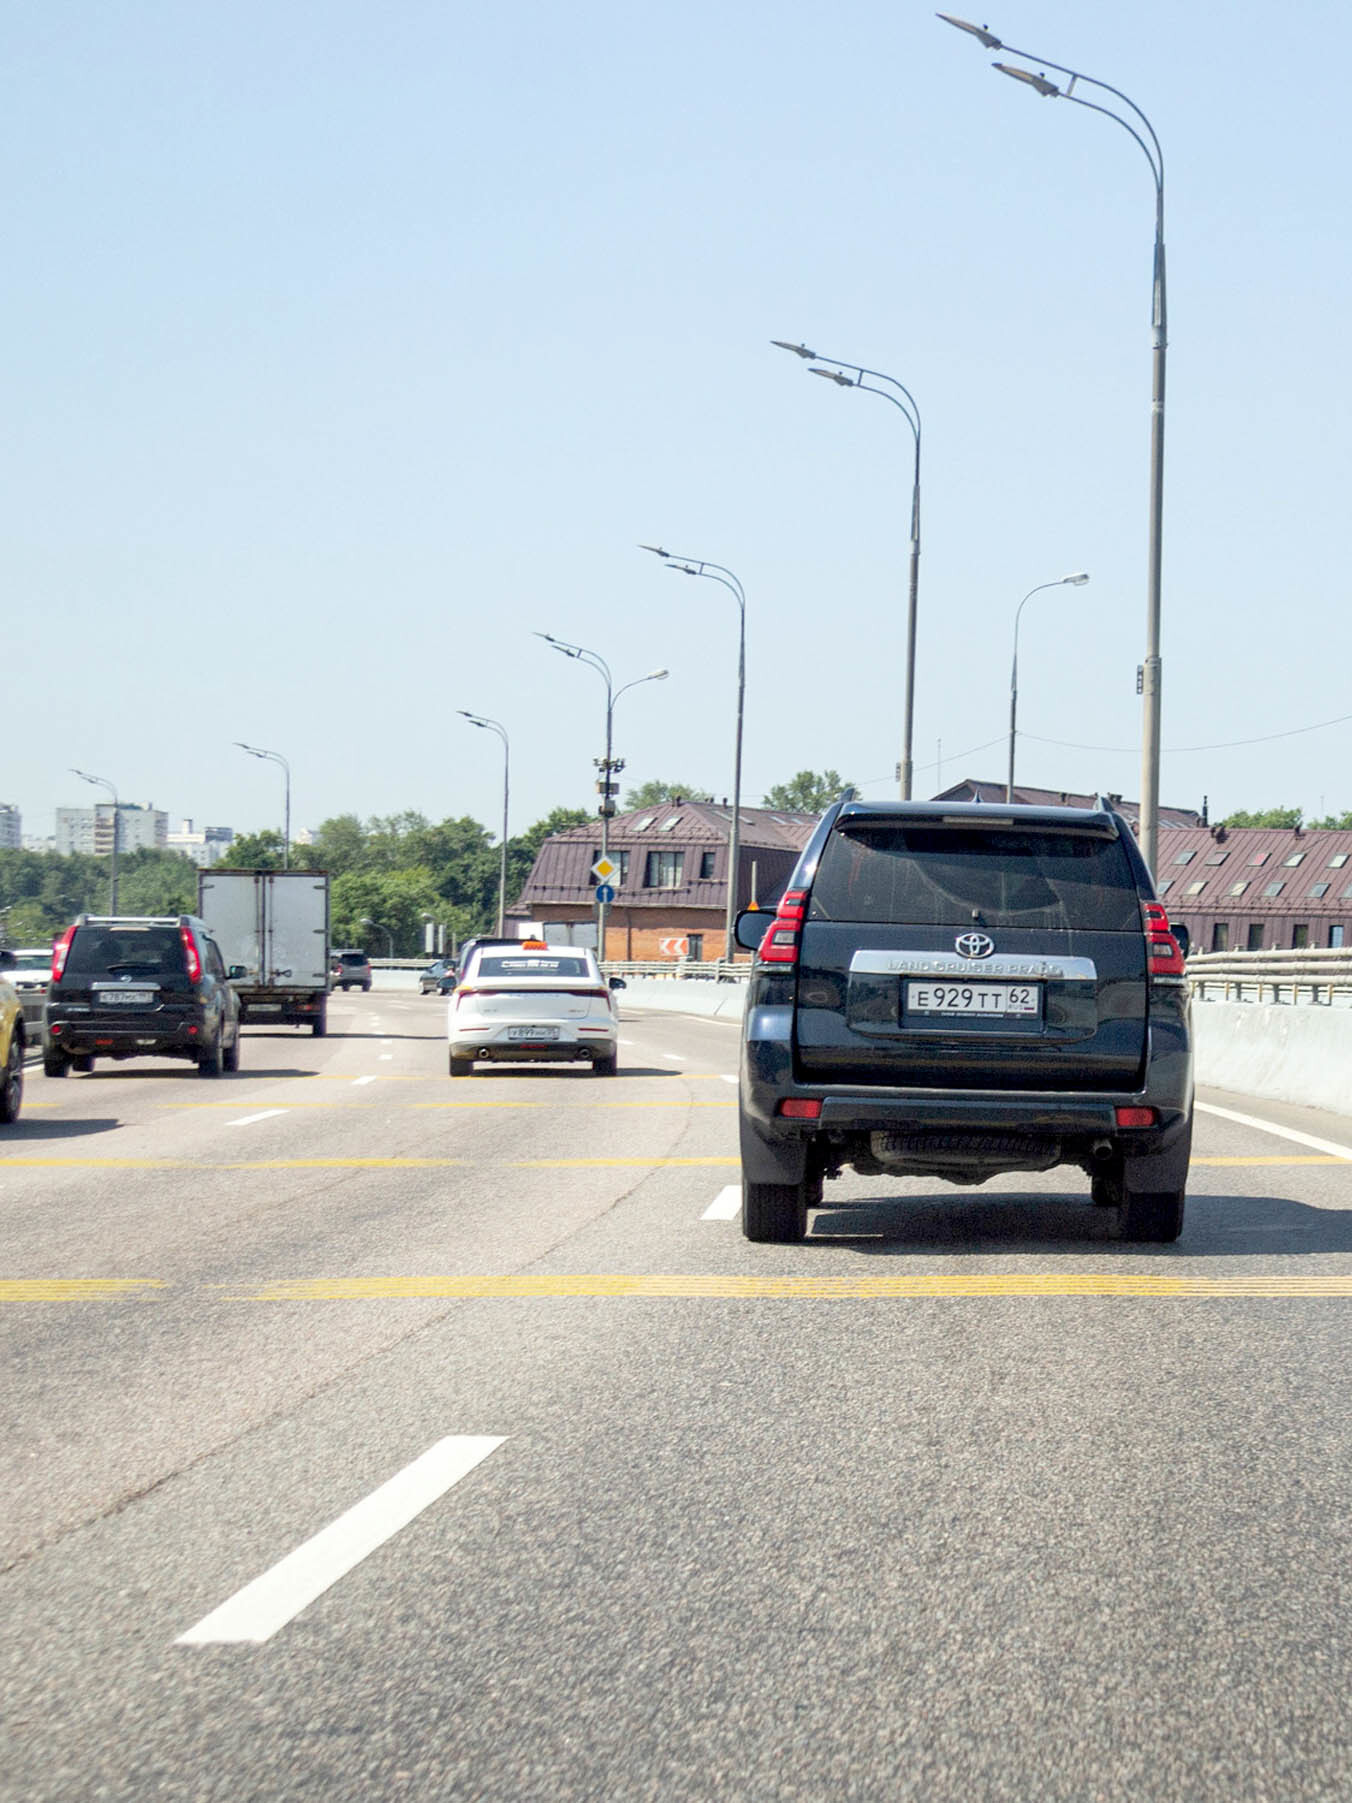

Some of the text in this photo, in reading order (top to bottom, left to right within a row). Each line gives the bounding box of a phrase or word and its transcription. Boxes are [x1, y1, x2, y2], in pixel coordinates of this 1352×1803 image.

[887, 960, 929, 971] LAND
[933, 961, 1002, 974] CRUISER
[1009, 988, 1030, 1004] 62
